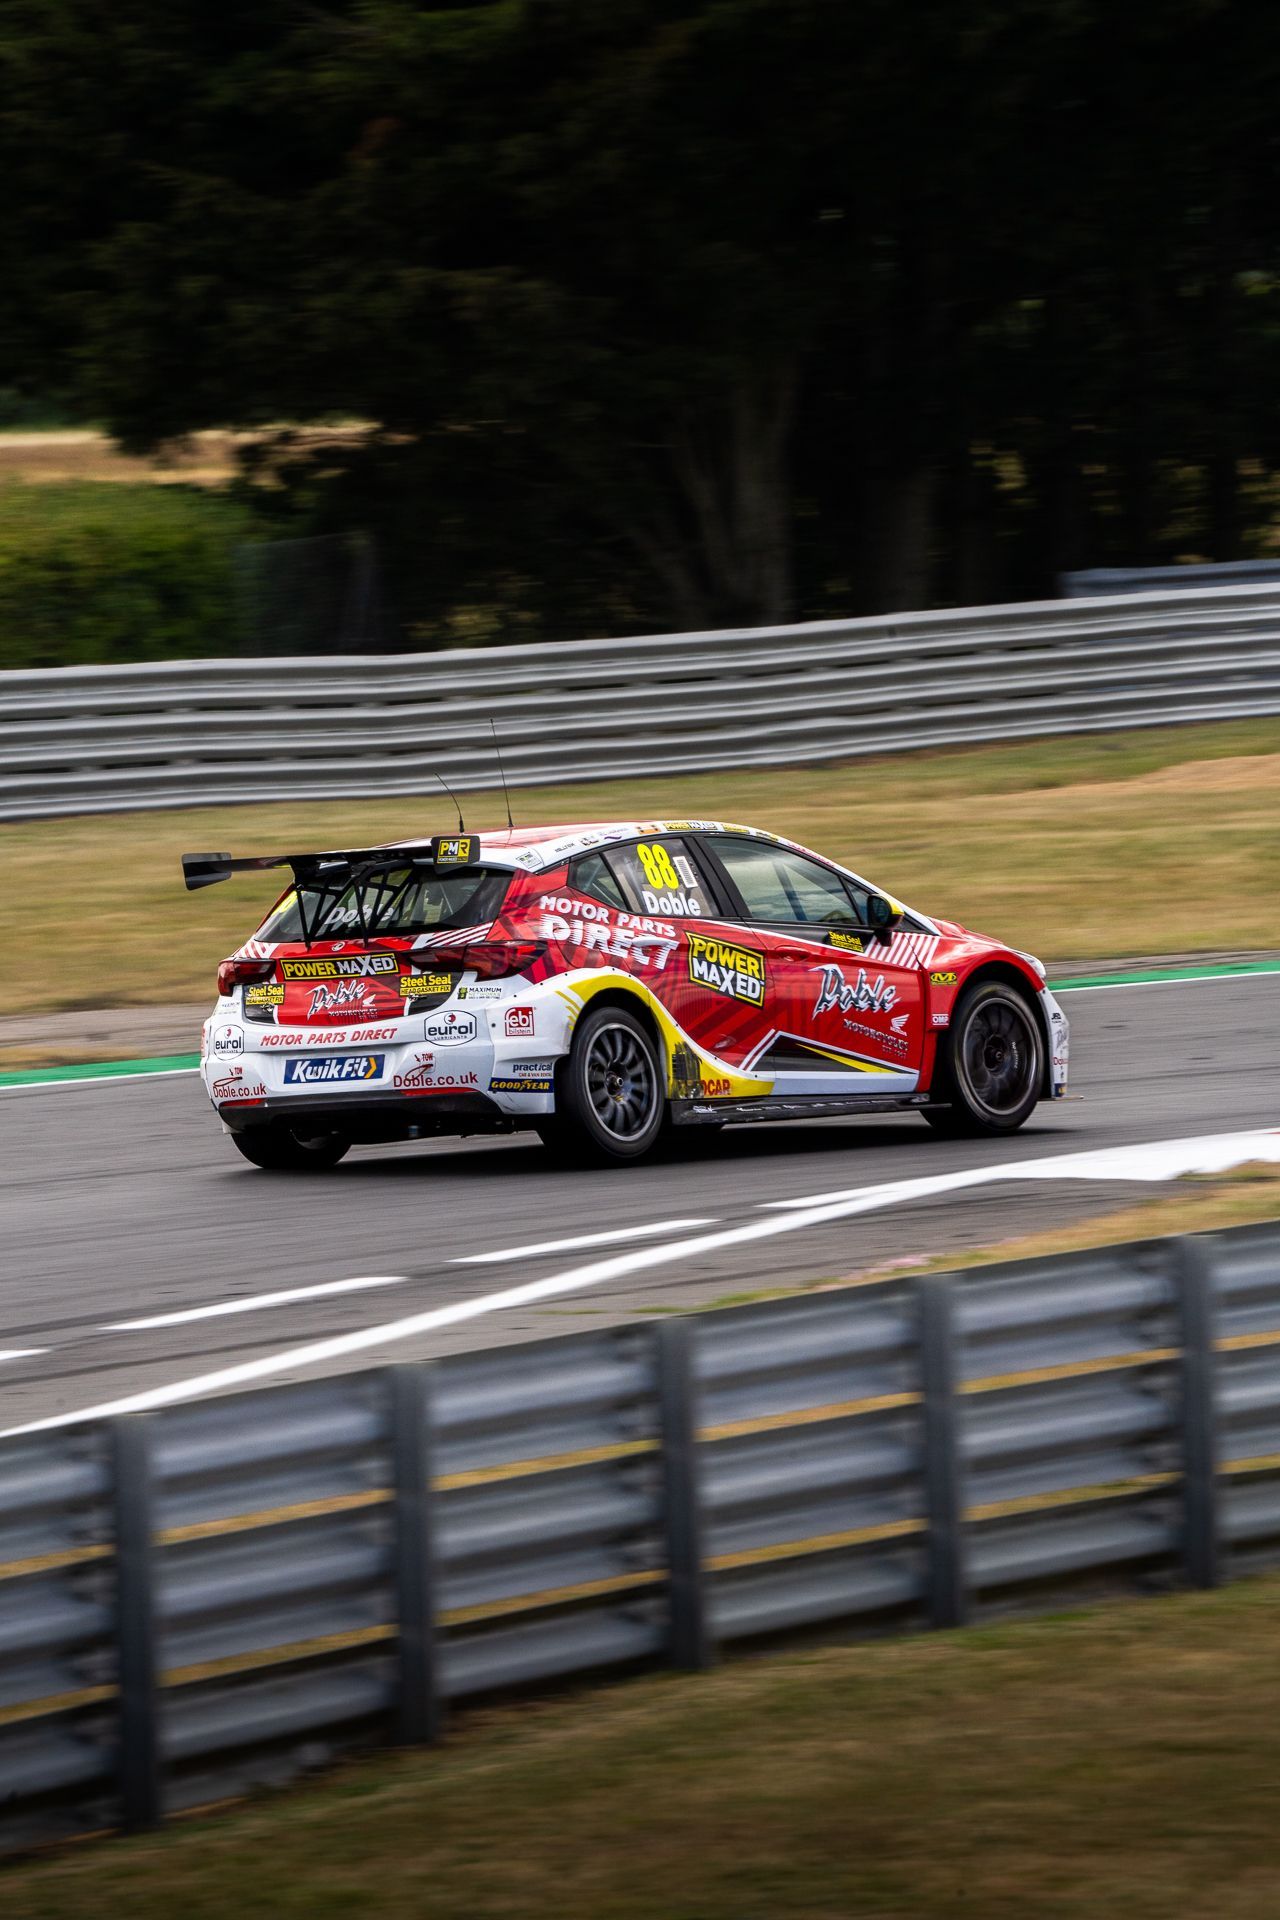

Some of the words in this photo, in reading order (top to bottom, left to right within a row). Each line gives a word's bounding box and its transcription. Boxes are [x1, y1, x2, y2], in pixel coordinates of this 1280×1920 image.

[440, 841, 469, 856] PMR
[637, 844, 679, 889] 88
[642, 890, 701, 916] Doble
[540, 895, 609, 924] MOTOR
[617, 912, 677, 937] PARTS
[539, 913, 680, 970] DIRECT
[284, 961, 337, 976] POWER
[336, 955, 395, 976] MAXED
[692, 937, 761, 979] POWER
[400, 975, 427, 987] Steel
[429, 974, 452, 985] Seal
[692, 957, 761, 999] MAXED
[249, 986, 267, 997] Steel
[267, 984, 284, 995] Seal
[807, 964, 901, 1020] Doble
[505, 1007, 533, 1027] febi
[260, 1034, 303, 1046] MOTOR
[307, 1032, 346, 1045] PARTS
[351, 1028, 398, 1042] DIRECT
[428, 1022, 473, 1036] eurol
[215, 1036, 242, 1049] eurol
[513, 1063, 552, 1073] practical
[393, 1072, 478, 1088] Doble.co.uk
[213, 1083, 266, 1098] Doble.co.uk
